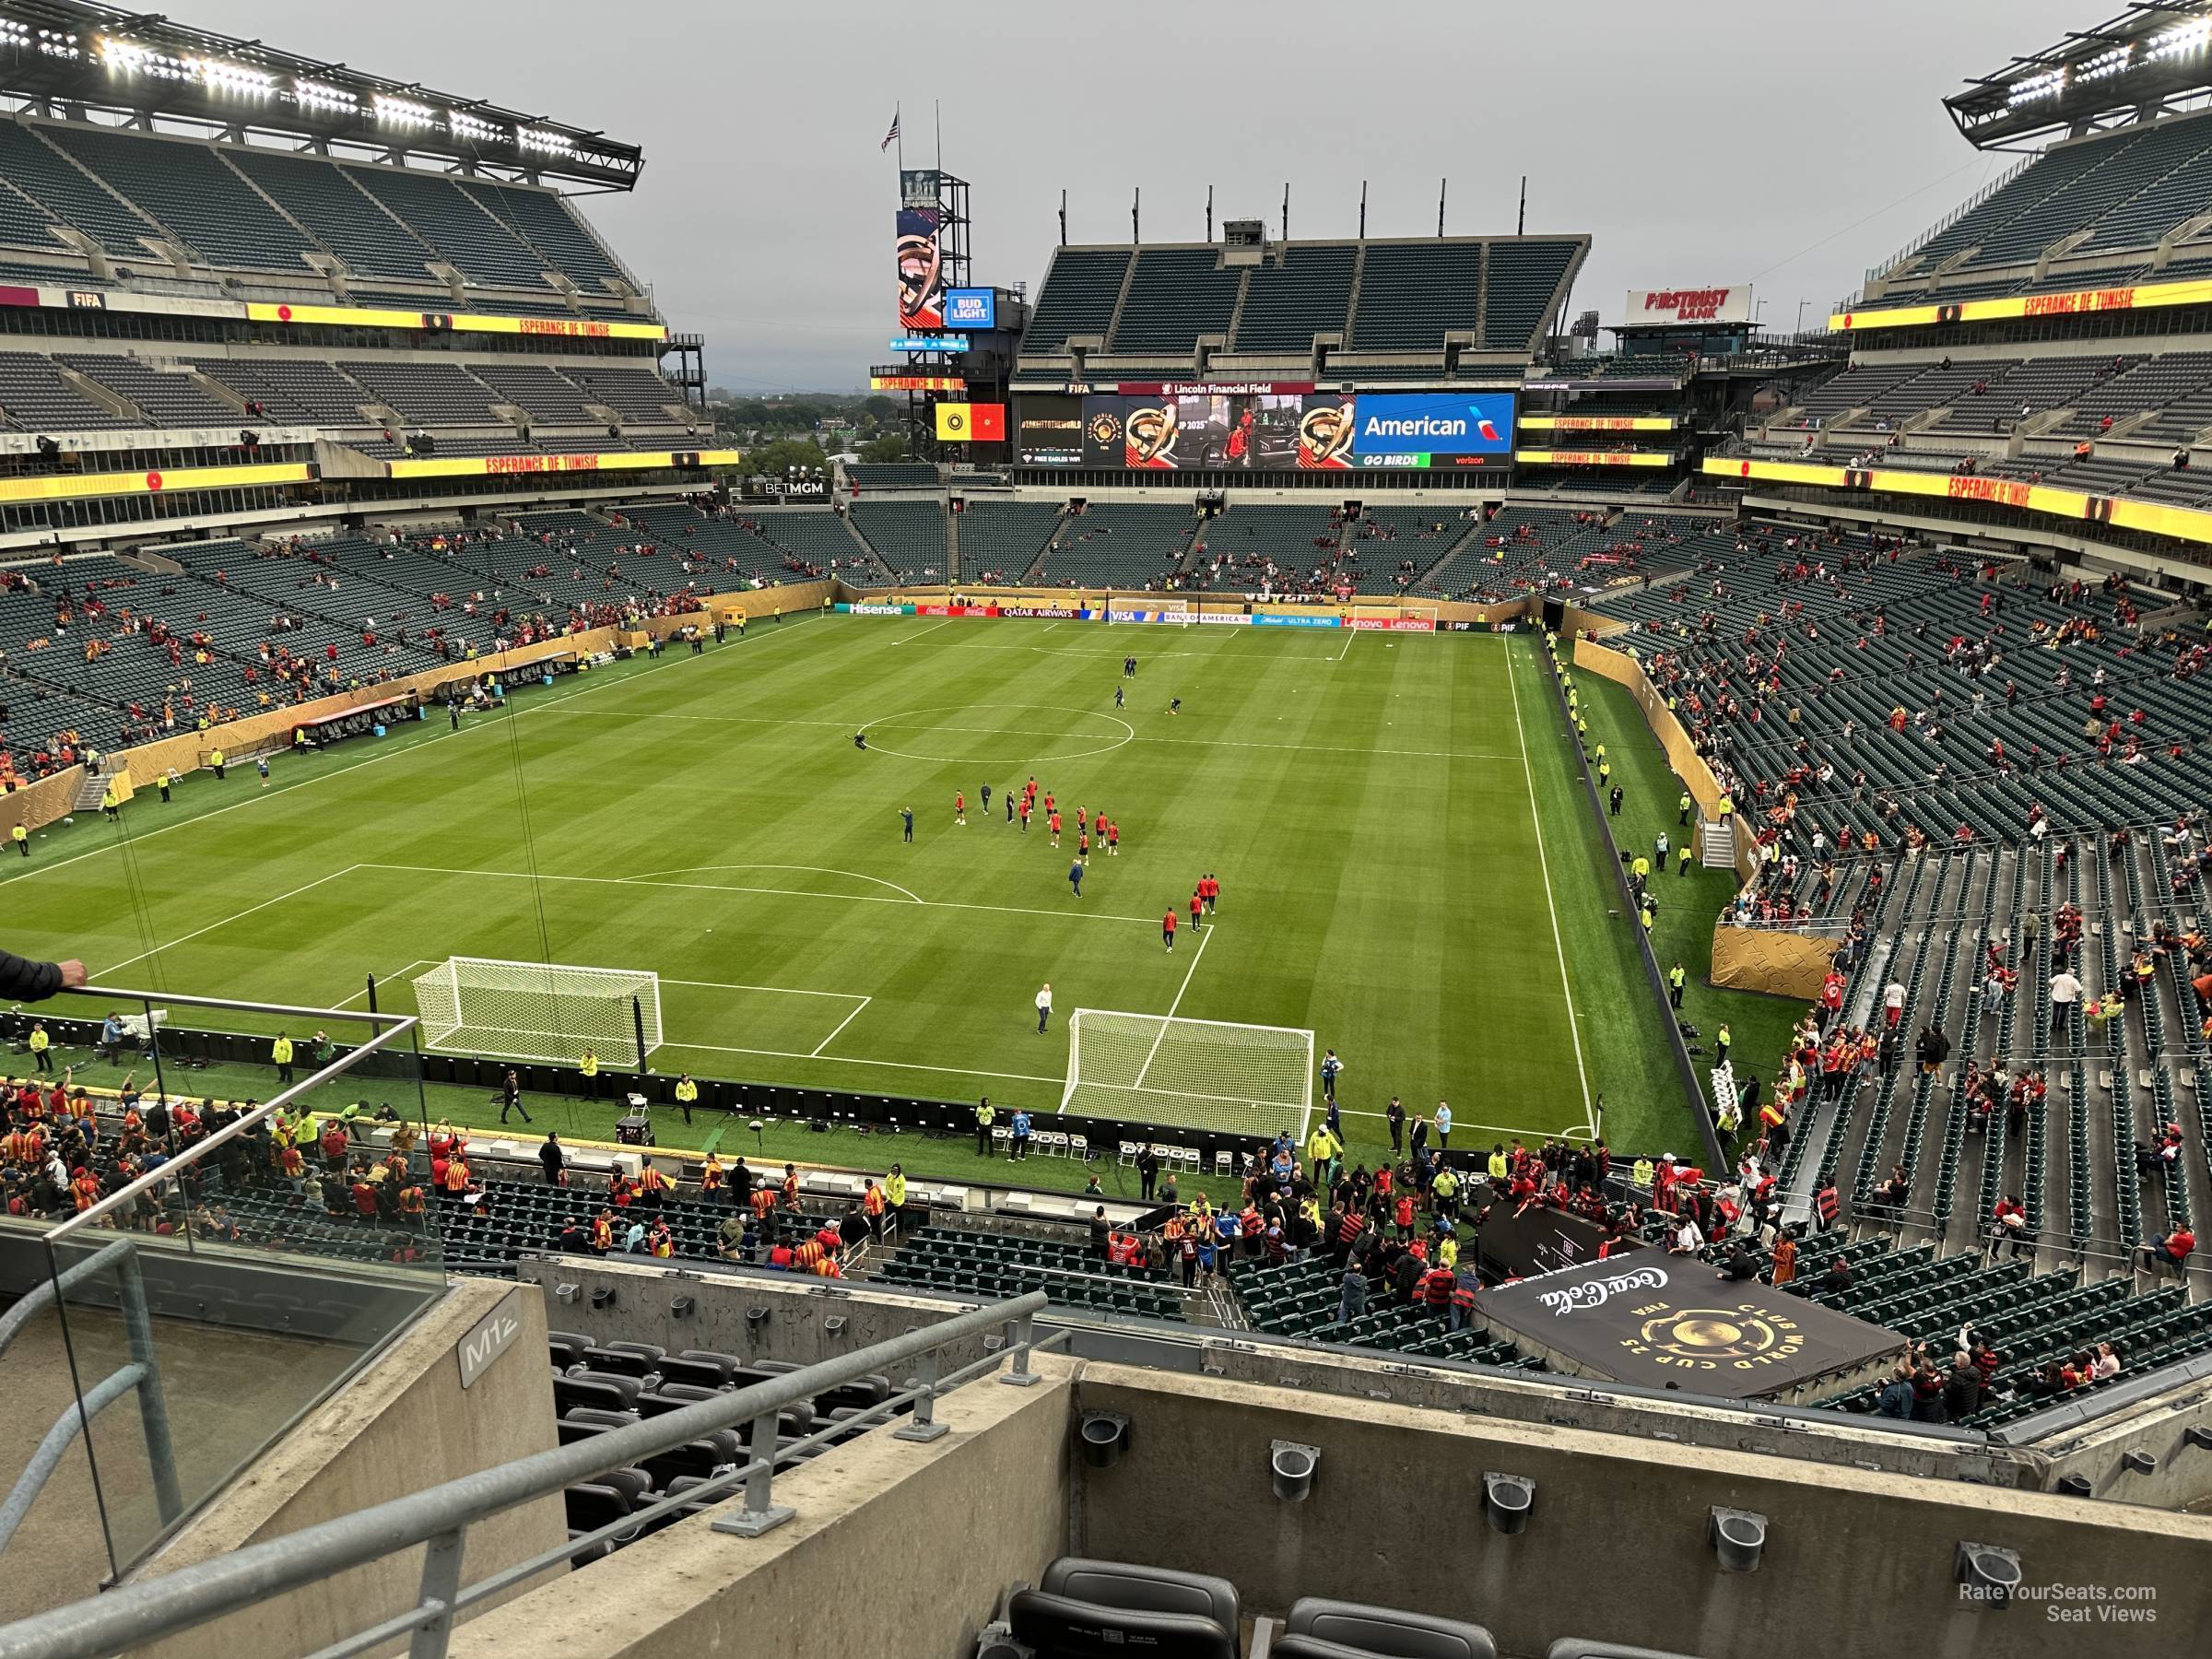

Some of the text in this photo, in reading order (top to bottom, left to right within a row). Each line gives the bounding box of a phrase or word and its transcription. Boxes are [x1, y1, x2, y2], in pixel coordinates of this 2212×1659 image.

[73, 292, 102, 307] FIFA
[957, 299, 982, 309] BUD
[2024, 288, 2135, 315] ESPERANCE DE TUNISIE
[953, 308, 988, 319] LIGHT
[1677, 307, 1719, 320] BANK
[519, 320, 610, 336] ESPERANCE DE TUNISIE
[880, 378, 929, 391] ESPERANCE
[933, 378, 946, 391] DE
[1069, 384, 1090, 394] FIFA
[1174, 383, 1271, 394] Lincoln Financial Field
[1364, 416, 1465, 436] American
[1554, 419, 1634, 429] ESPERANCE DE TUNISIE
[1363, 454, 1419, 465] GO BIRDS
[1455, 456, 1484, 465] verizon
[1551, 453, 1630, 464] ESPERANCE DE TUNISIE
[486, 454, 598, 475] ESPERANCE DE TUNISIE
[766, 483, 823, 493] BETMGM
[1948, 477, 1997, 501] ESPERANCE
[850, 604, 902, 615] Hisense
[1005, 608, 1073, 618] QATAR AIRWAYS
[1112, 612, 1135, 621] VISA
[1345, 618, 1382, 629] Lenovo
[1391, 618, 1430, 629] Lenovo
[1455, 622, 1470, 630] PIF
[1500, 624, 1516, 632] PIF
[1540, 1267, 1668, 1316] Coca-Cola
[1630, 1301, 1671, 1316] FIFA
[1619, 1304, 1805, 1370] CLUB WORLD CUP 25
[465, 1317, 518, 1371] M12
